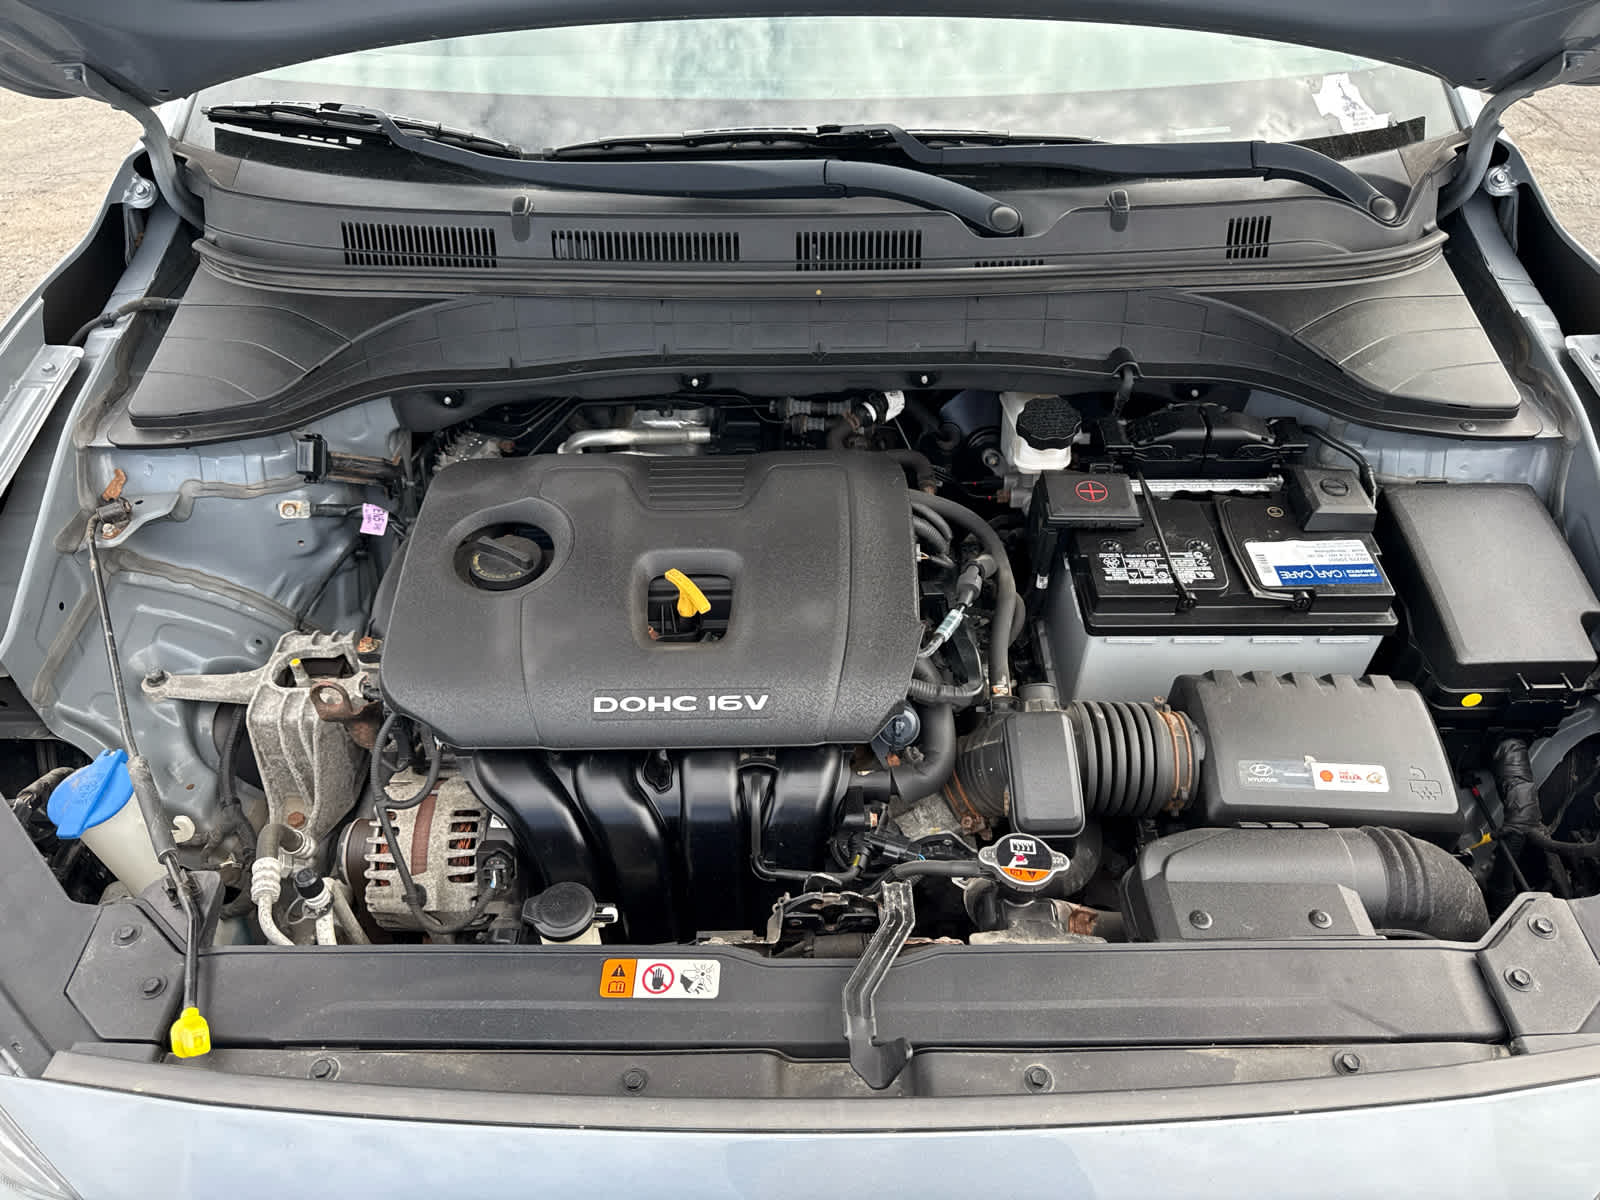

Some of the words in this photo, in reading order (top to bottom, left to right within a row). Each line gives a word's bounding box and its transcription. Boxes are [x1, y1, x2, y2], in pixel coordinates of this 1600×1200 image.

[1279, 569, 1314, 579] CARE
[1315, 569, 1343, 578] CAR
[593, 695, 698, 713] DOHC
[707, 694, 769, 711] 16V
